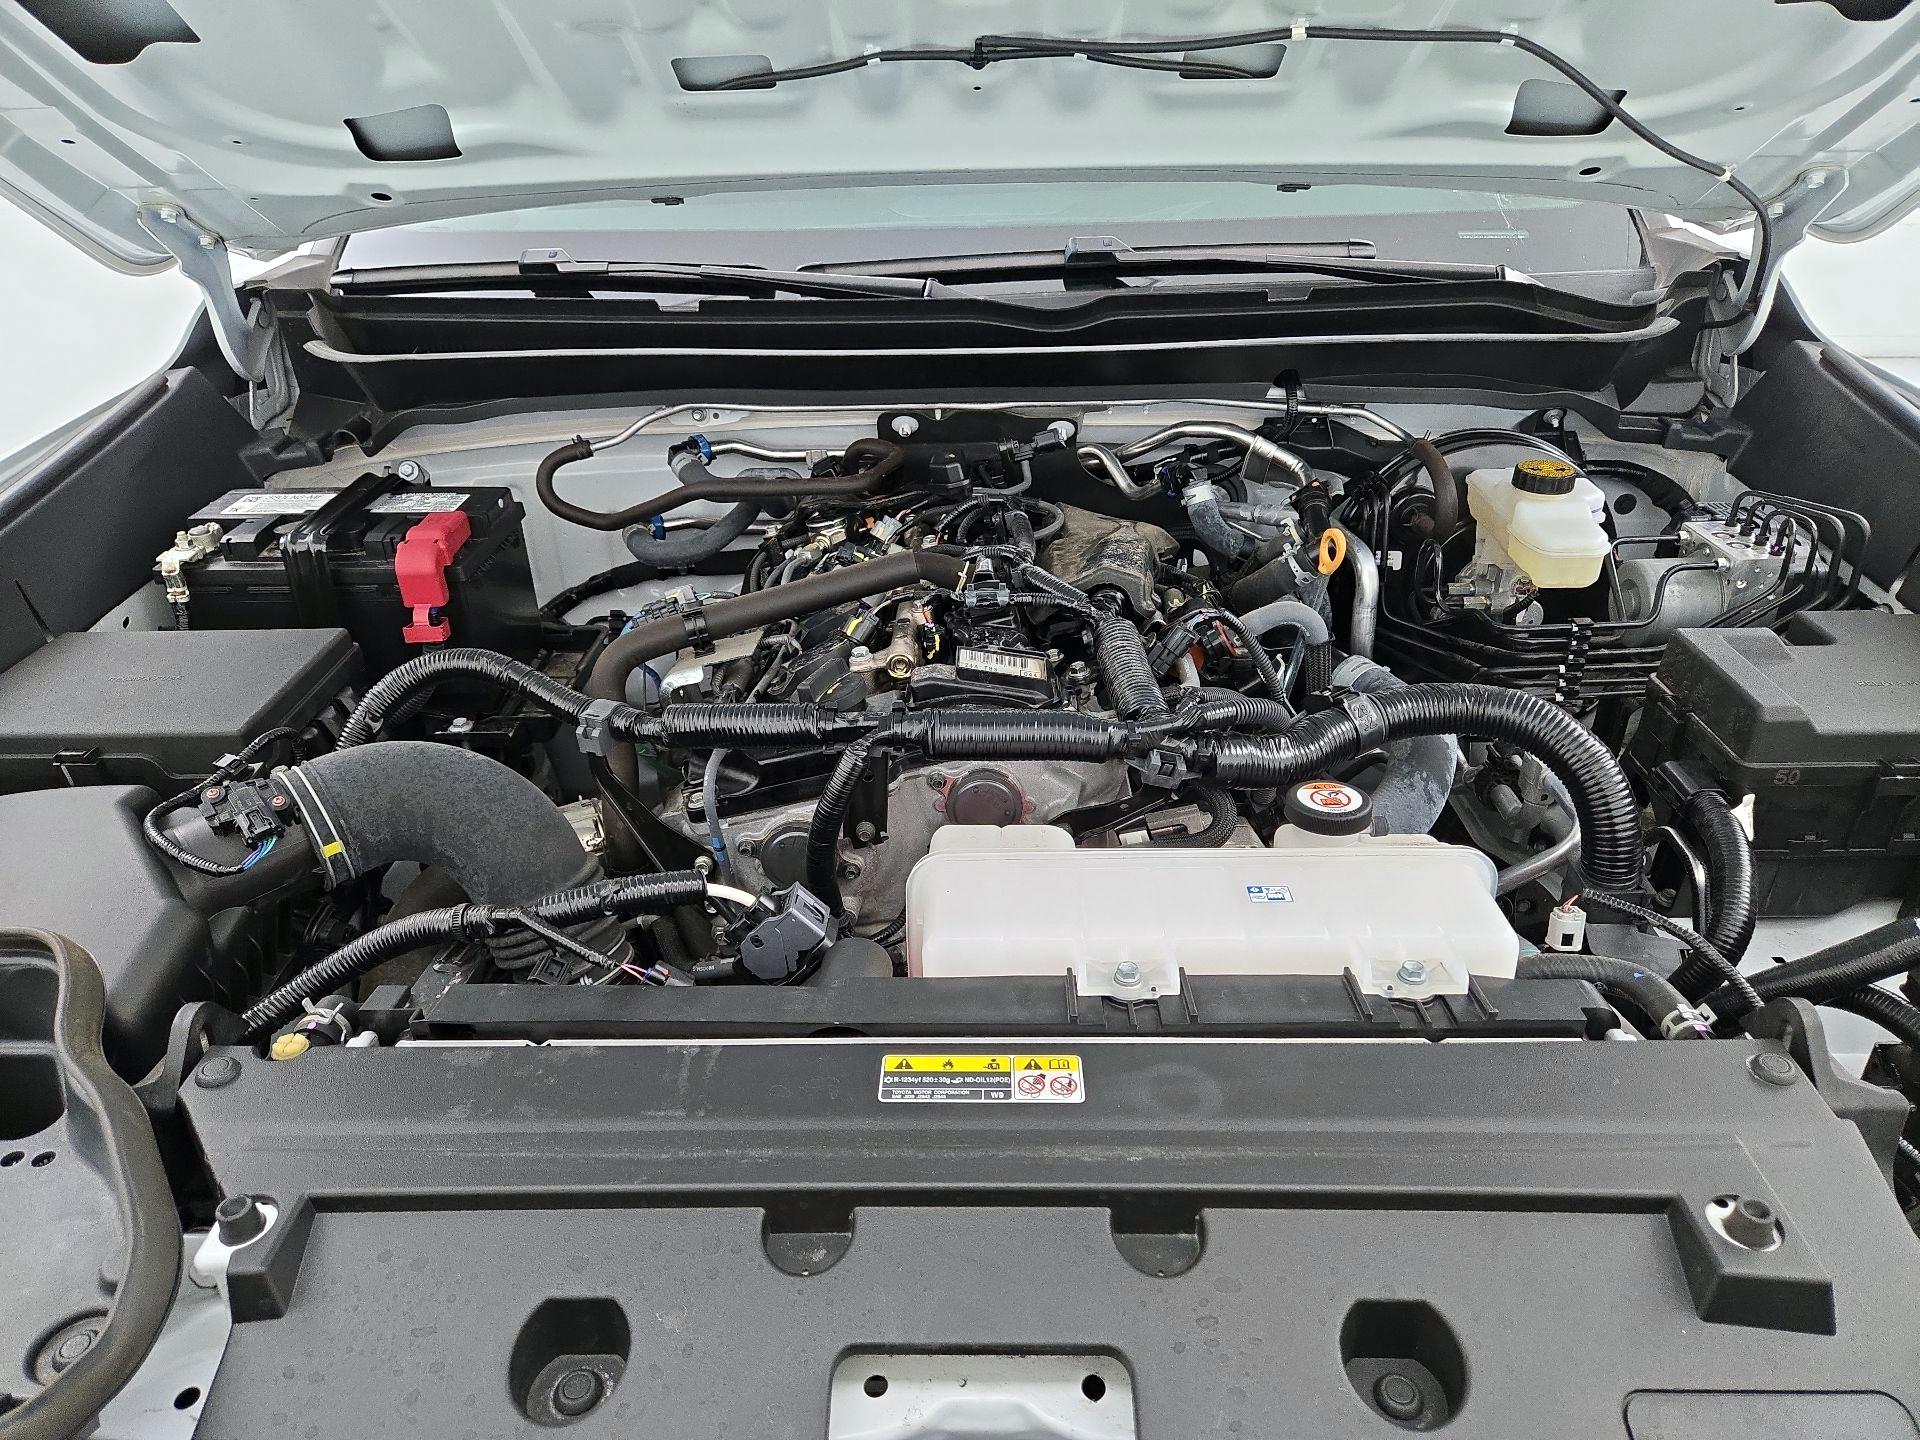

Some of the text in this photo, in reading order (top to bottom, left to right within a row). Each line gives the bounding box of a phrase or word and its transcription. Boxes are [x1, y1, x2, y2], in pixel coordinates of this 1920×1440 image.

[1773, 769, 1801, 785] 50
[893, 1076, 921, 1084] R-1234yf
[964, 1076, 1011, 1084] ND-OIL12(POE)
[990, 1091, 1004, 1099] W9
